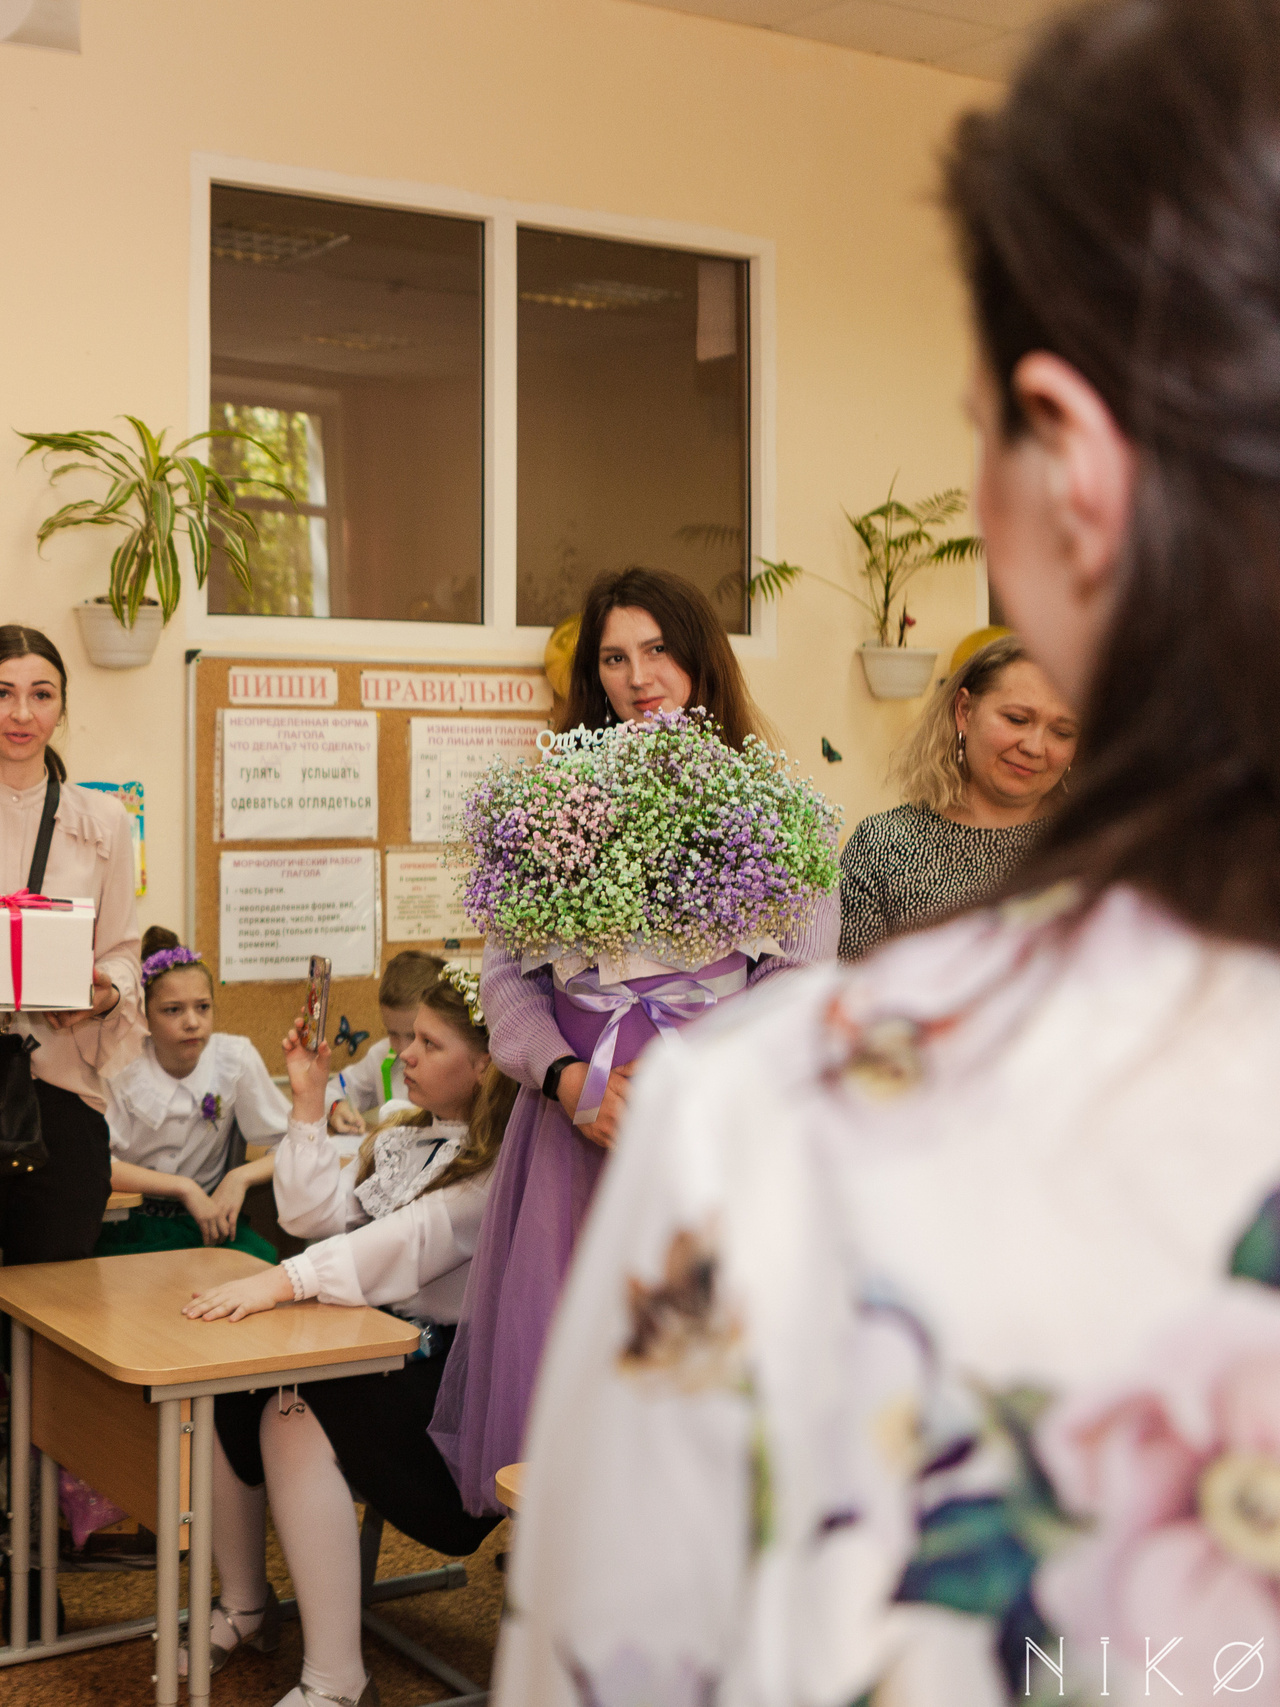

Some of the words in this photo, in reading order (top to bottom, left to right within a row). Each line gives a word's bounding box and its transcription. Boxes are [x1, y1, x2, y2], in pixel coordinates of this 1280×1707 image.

[231, 674, 327, 698] ПИШИ
[362, 677, 534, 703] ПРАВИЛЬНО
[230, 717, 329, 727] НЕОПРЕДЕЛЕННАЯ
[332, 718, 369, 728] ФОРМА
[277, 730, 325, 739] ГЛАГОЛА
[427, 725, 492, 735] ИЗМЕНЕНИЯ
[495, 726, 538, 736] ГЛАГОЛА
[230, 741, 249, 751] ЧТО
[252, 741, 297, 753] ДЕЛАТЬ?
[300, 741, 320, 751] ЧТО
[322, 741, 371, 753] СДЕЛАТЬ?
[428, 737, 444, 746] ПО
[447, 737, 484, 748] ЛИЦАМ
[487, 738, 494, 746] И
[497, 738, 537, 747] ЧИСЛАМ
[240, 767, 280, 782] гулять
[301, 767, 359, 782] услышать
[231, 796, 293, 812] одеваться
[298, 796, 371, 811] оглядеться
[233, 857, 328, 868] МОРФОЛОГИЧЕСКИЙ
[330, 856, 362, 865] РАЗБОР
[281, 868, 321, 878] ГЛАГОЛА
[239, 886, 263, 895] часть
[239, 903, 309, 914] неопределенная
[259, 955, 309, 966] предложени
